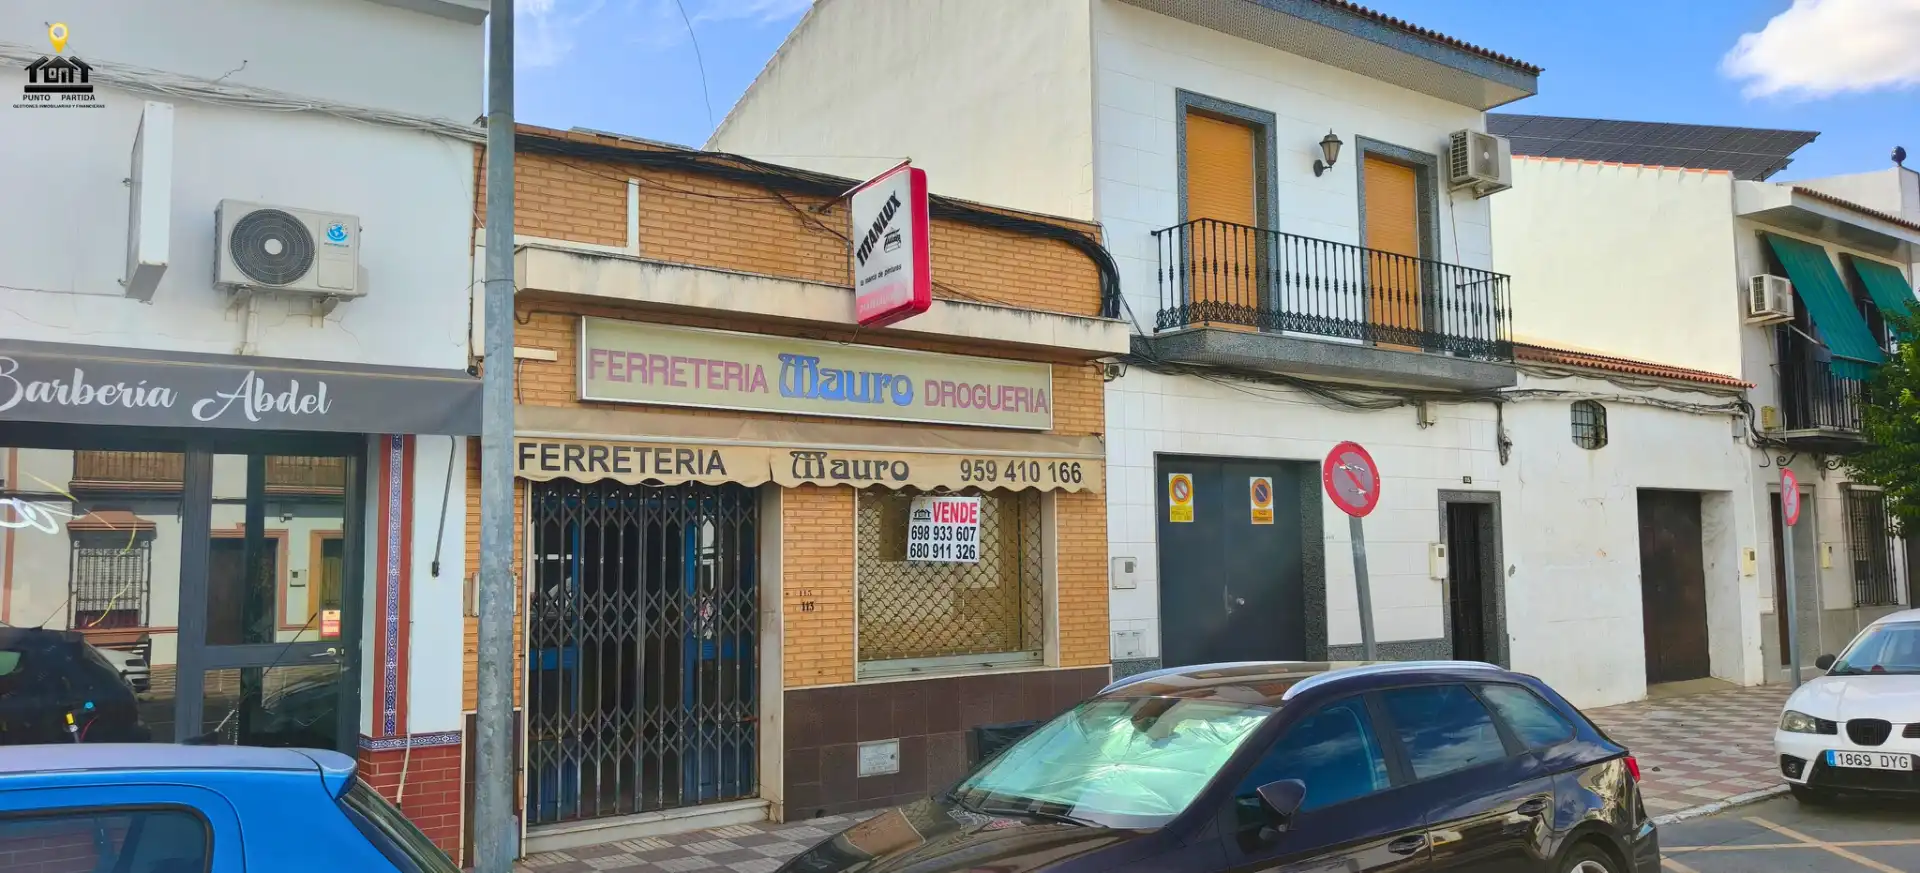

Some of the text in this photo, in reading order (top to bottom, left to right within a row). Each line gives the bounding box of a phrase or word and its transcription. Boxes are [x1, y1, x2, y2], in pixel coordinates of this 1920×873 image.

[856, 190, 901, 267] TITANLUX
[0, 357, 333, 422] Barbería Abdel
[588, 348, 1049, 414] FERRETERIA Mauro DROGUERIA
[518, 442, 1082, 484] FERRETERIA Mauro 959 410 166
[932, 501, 978, 524] VENDE
[911, 525, 977, 542] 698 933 607
[910, 543, 976, 560] 680 911 326
[1837, 753, 1908, 769] 1869 DYG
